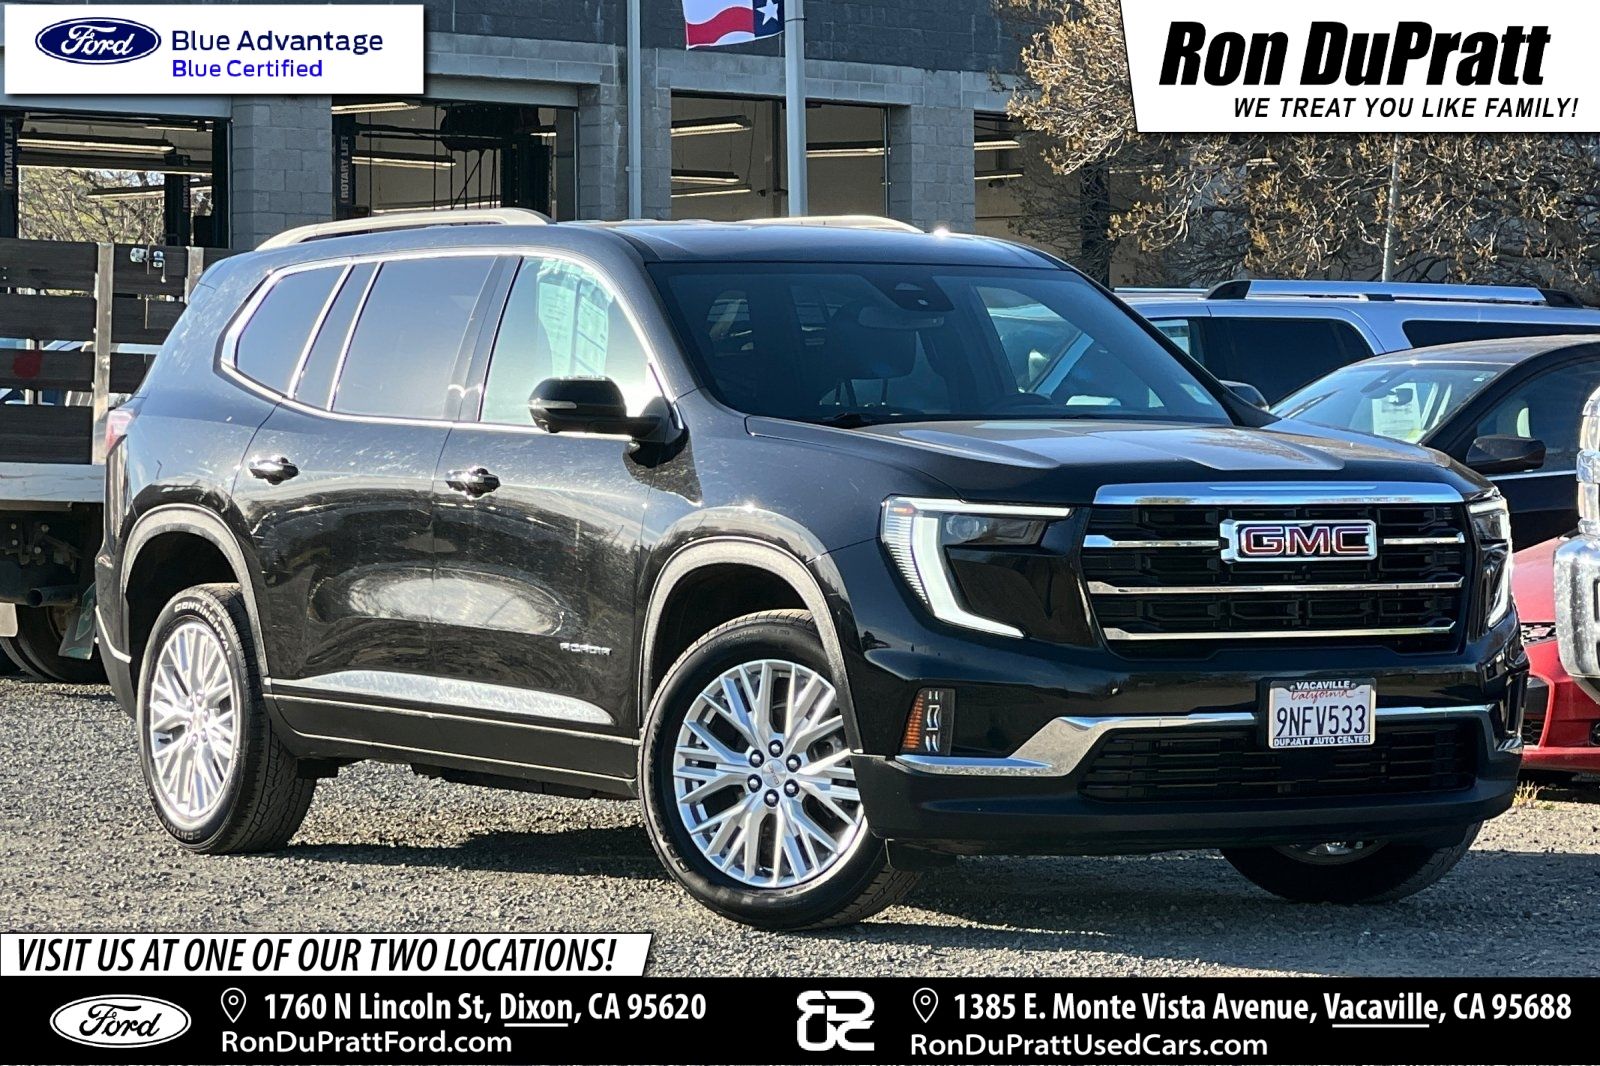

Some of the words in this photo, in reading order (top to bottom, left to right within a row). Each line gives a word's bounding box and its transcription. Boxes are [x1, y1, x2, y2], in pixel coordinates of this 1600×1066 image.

[4, 142, 13, 185] ROTARY
[340, 159, 349, 199] ROTARY
[1240, 526, 1369, 555] GMC
[1291, 690, 1354, 703] California
[1296, 681, 1350, 689] VACAVILLE
[1276, 704, 1366, 737] 9NFV533
[1274, 737, 1311, 747] DUPRATT
[1313, 736, 1334, 745] AUTO
[1337, 735, 1370, 744] CENTER
